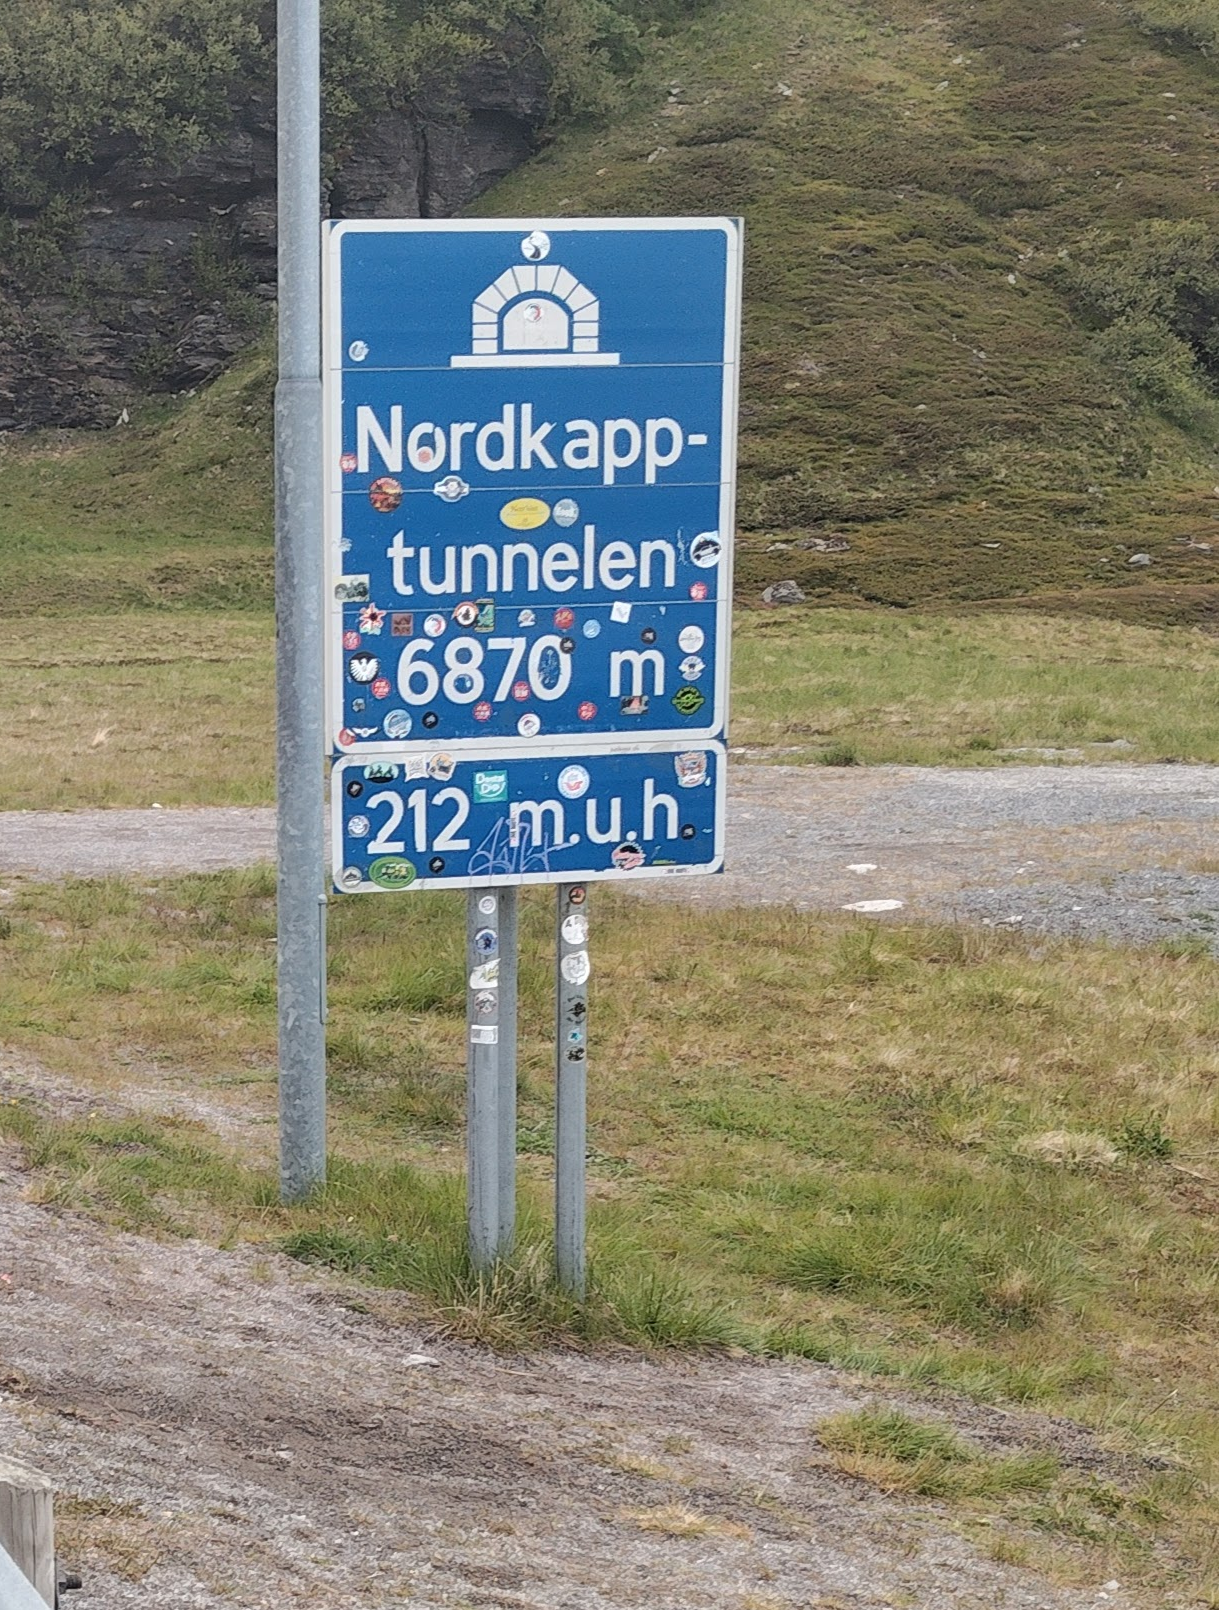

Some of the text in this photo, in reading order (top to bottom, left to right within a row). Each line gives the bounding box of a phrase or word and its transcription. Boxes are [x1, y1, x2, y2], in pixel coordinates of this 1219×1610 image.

[356, 403, 707, 485] Nordkapp-
[387, 525, 675, 595] tunnelen
[397, 634, 664, 706] 6870 m
[366, 786, 471, 854] 212
